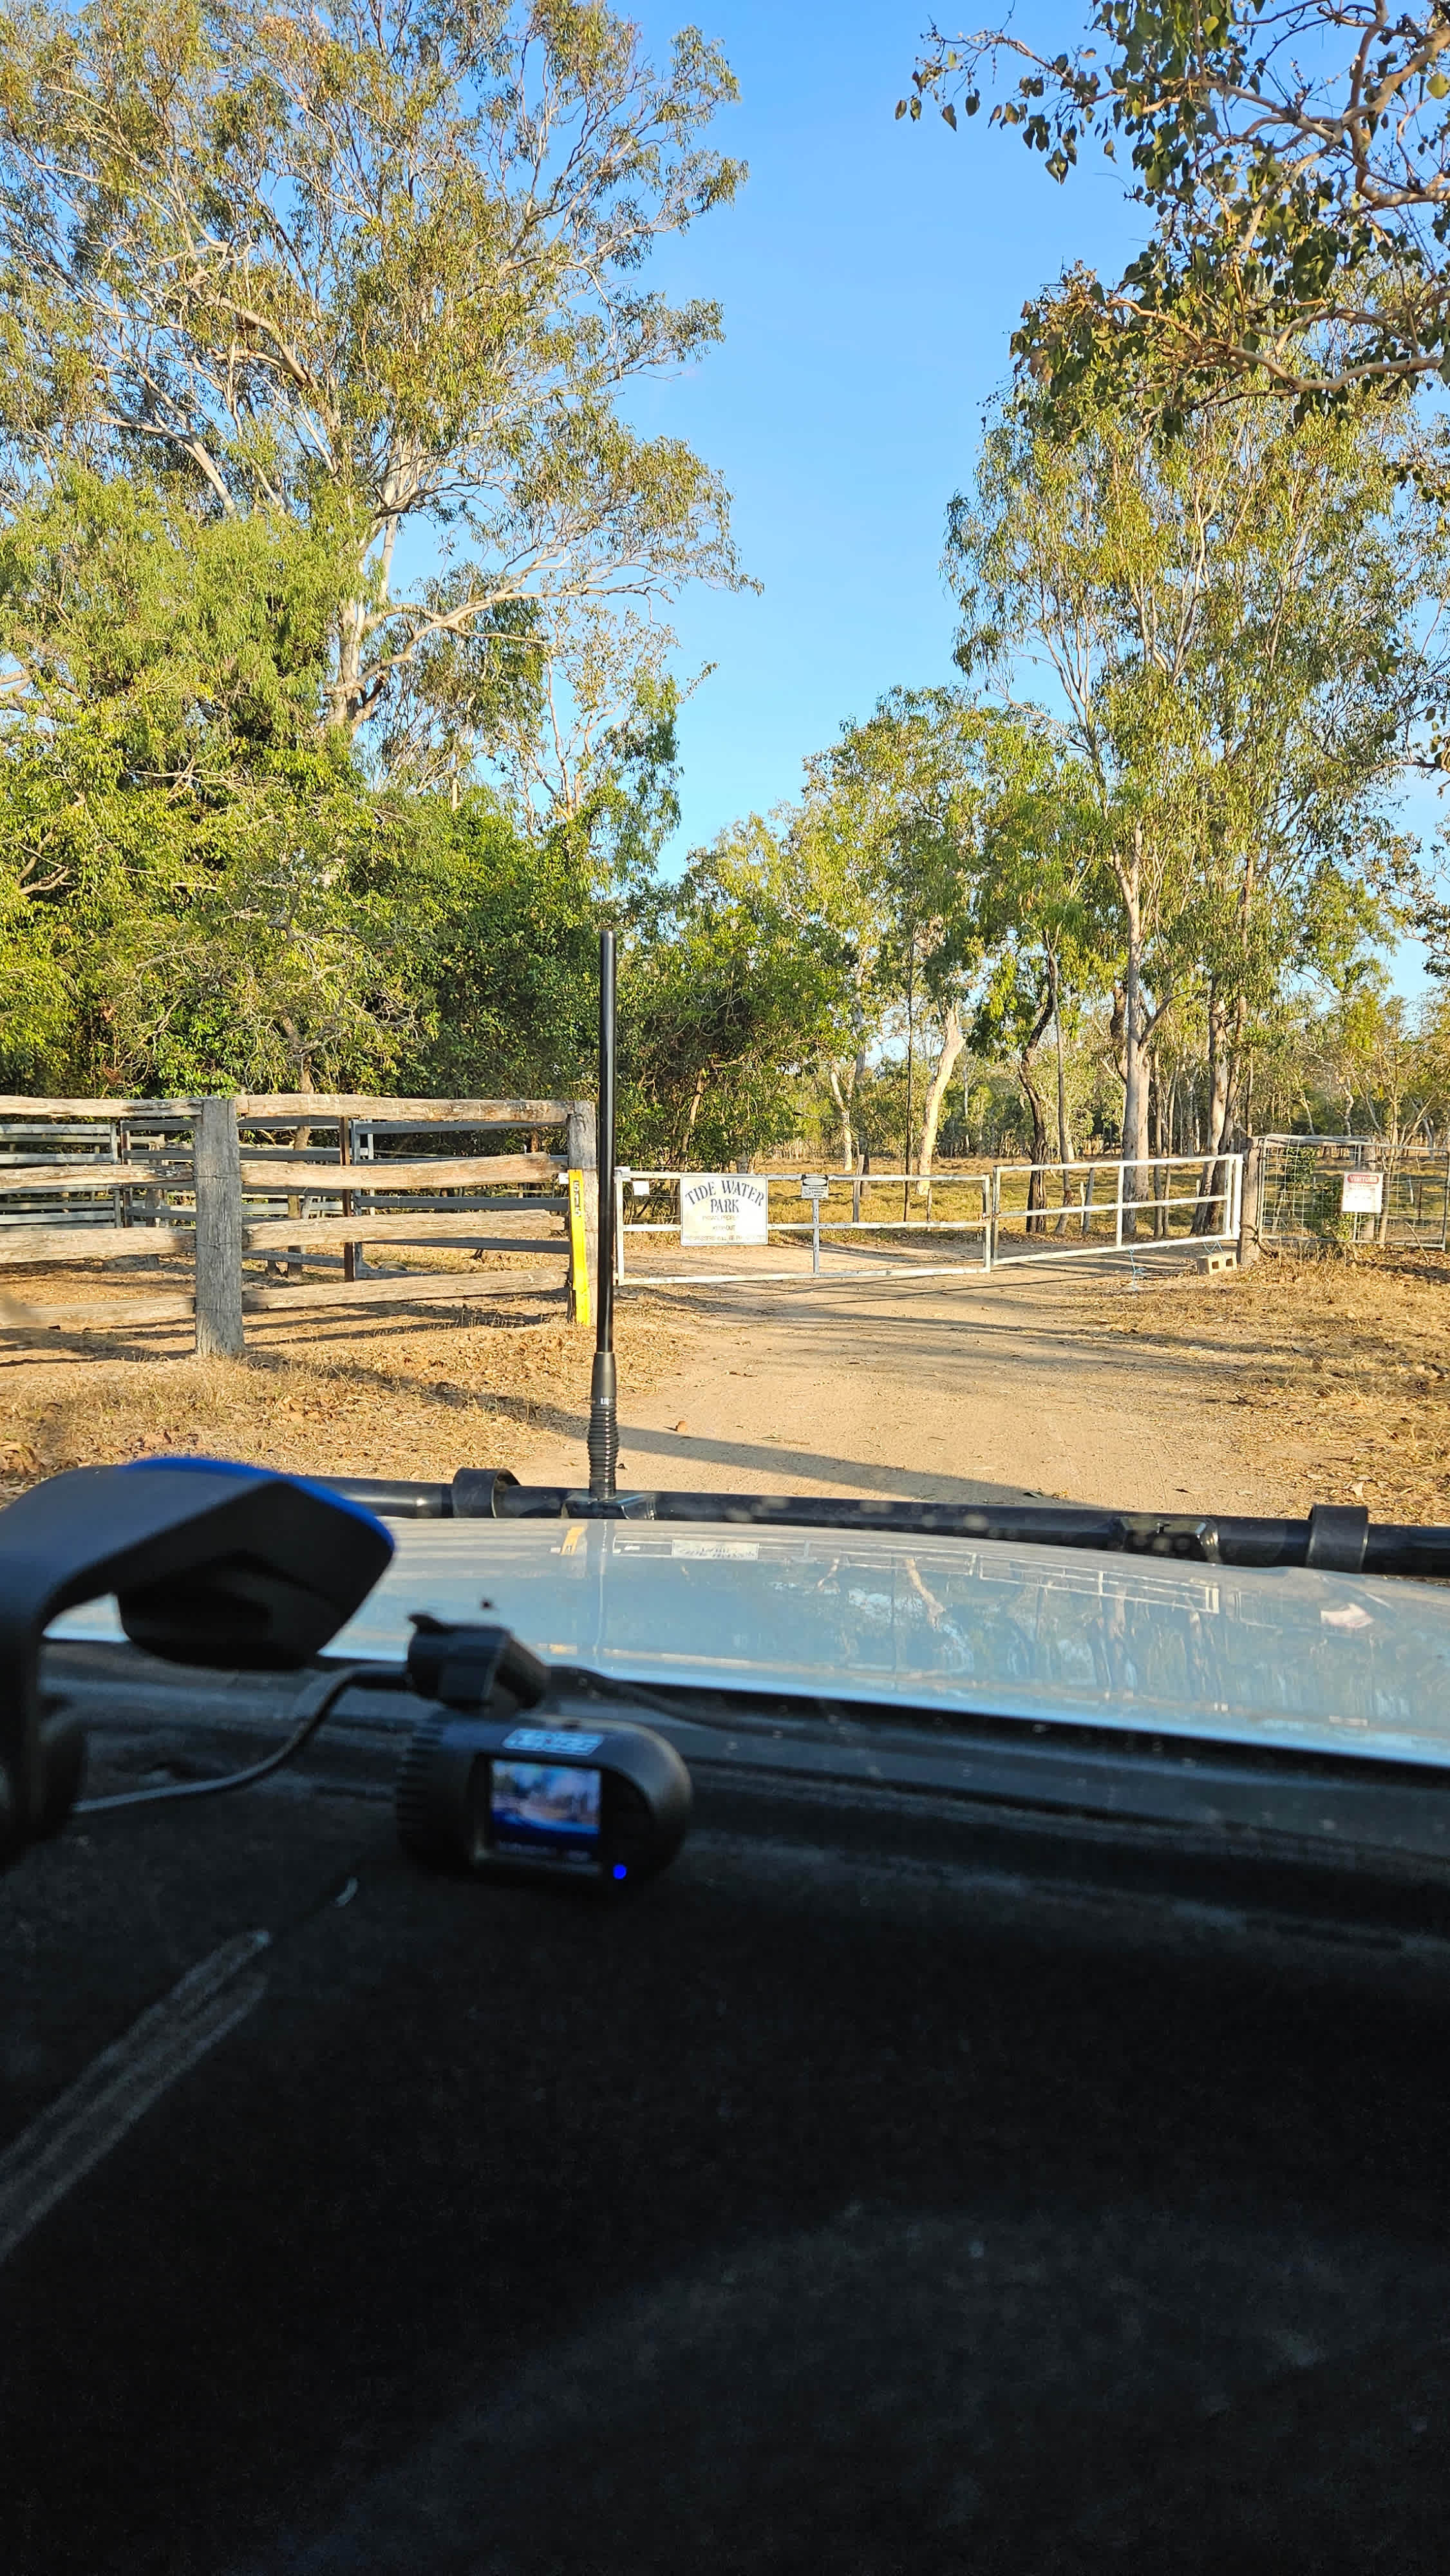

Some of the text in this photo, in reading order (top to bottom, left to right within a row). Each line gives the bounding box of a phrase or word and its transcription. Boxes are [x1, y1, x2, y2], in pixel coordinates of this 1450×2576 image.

[685, 1180, 764, 1206] TIDE WATER
[710, 1198, 739, 1213] PARK
